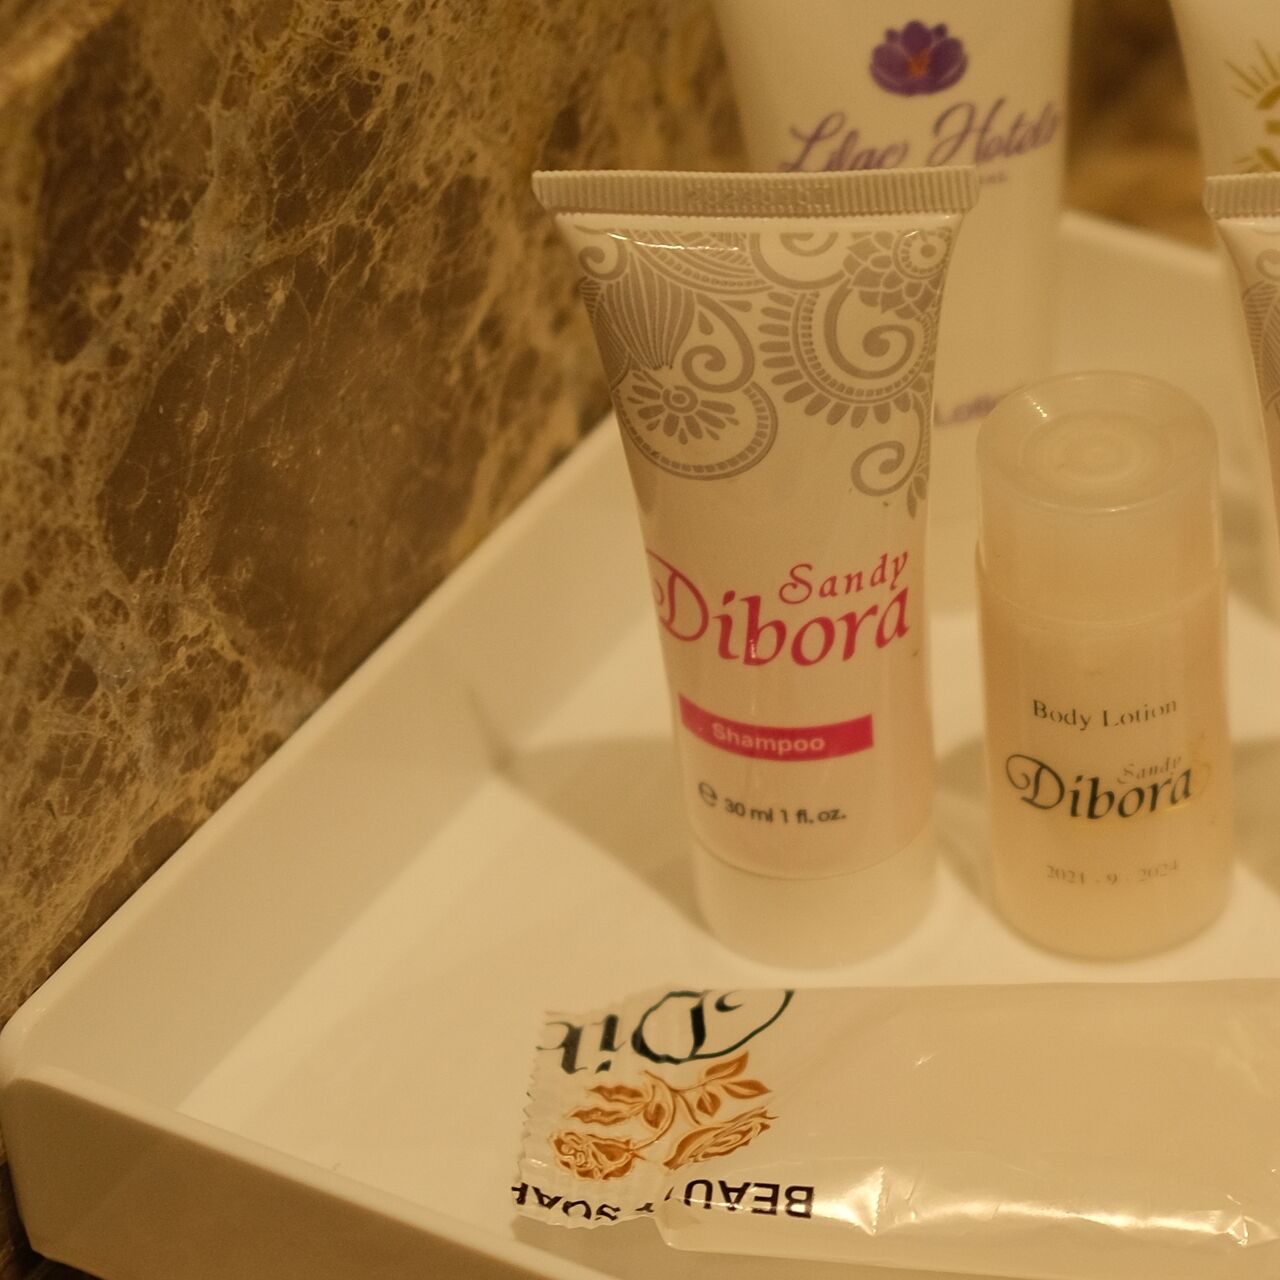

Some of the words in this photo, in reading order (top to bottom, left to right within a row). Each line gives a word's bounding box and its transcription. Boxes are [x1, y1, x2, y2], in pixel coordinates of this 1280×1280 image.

[778, 551, 910, 605] Sandy
[645, 547, 911, 667] Dibora
[1032, 699, 1091, 731] Body
[1103, 700, 1177, 727] Lotion
[712, 722, 826, 756] Shampoo
[1005, 753, 1192, 820] Dibora
[724, 798, 746, 817] 30
[750, 808, 773, 823] ml
[781, 809, 788, 824] 1
[818, 807, 847, 822] oz.
